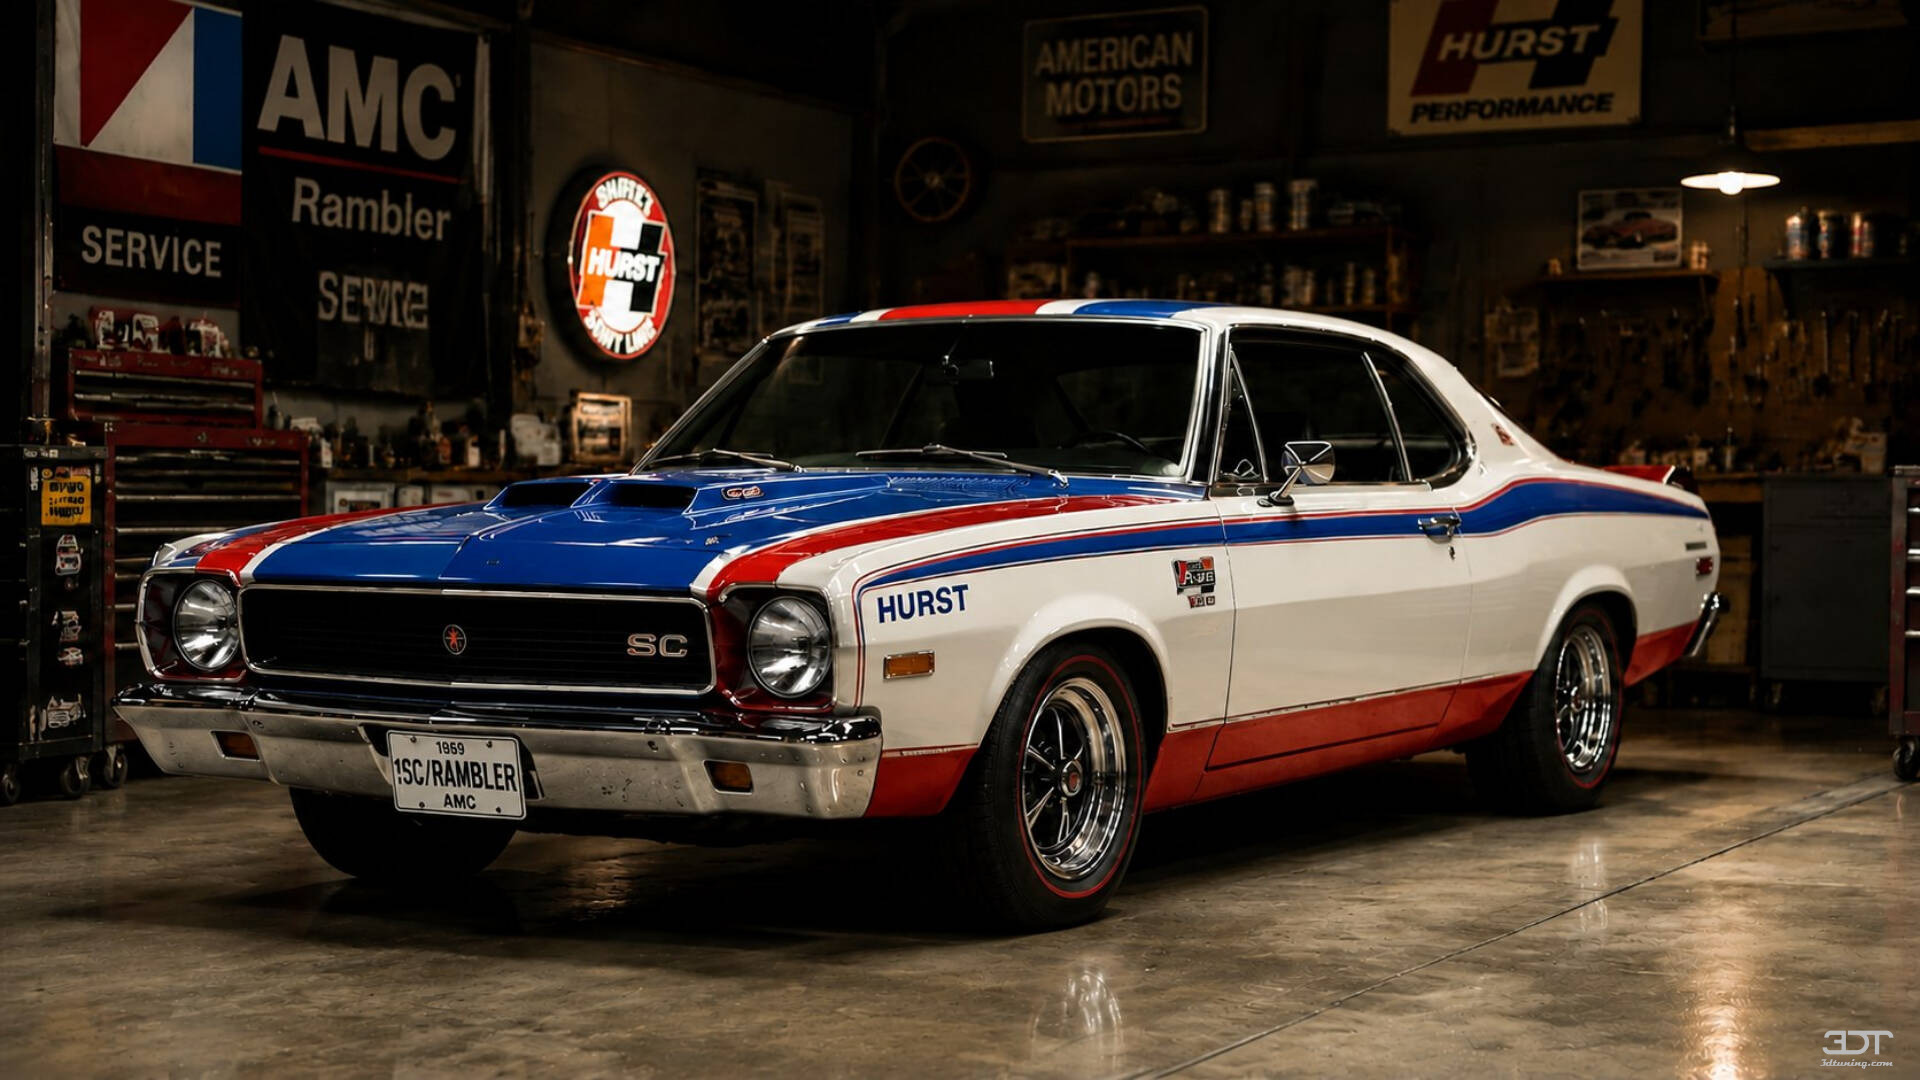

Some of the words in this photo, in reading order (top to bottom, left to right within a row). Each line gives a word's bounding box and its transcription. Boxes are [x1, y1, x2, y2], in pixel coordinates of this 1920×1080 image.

[1033, 31, 1193, 77] AMERICAN
[1437, 23, 1600, 62] HURST
[257, 33, 456, 162] AMC
[1045, 73, 1183, 117] MOTORS
[1411, 93, 1614, 123] PERFORMANCE
[291, 176, 452, 241] Rambler
[81, 224, 223, 278] SERVICE
[588, 247, 661, 282] HURST
[877, 584, 968, 623] HURST
[627, 633, 688, 658] SC
[436, 741, 465, 755] 1969
[443, 793, 476, 810] AMC
